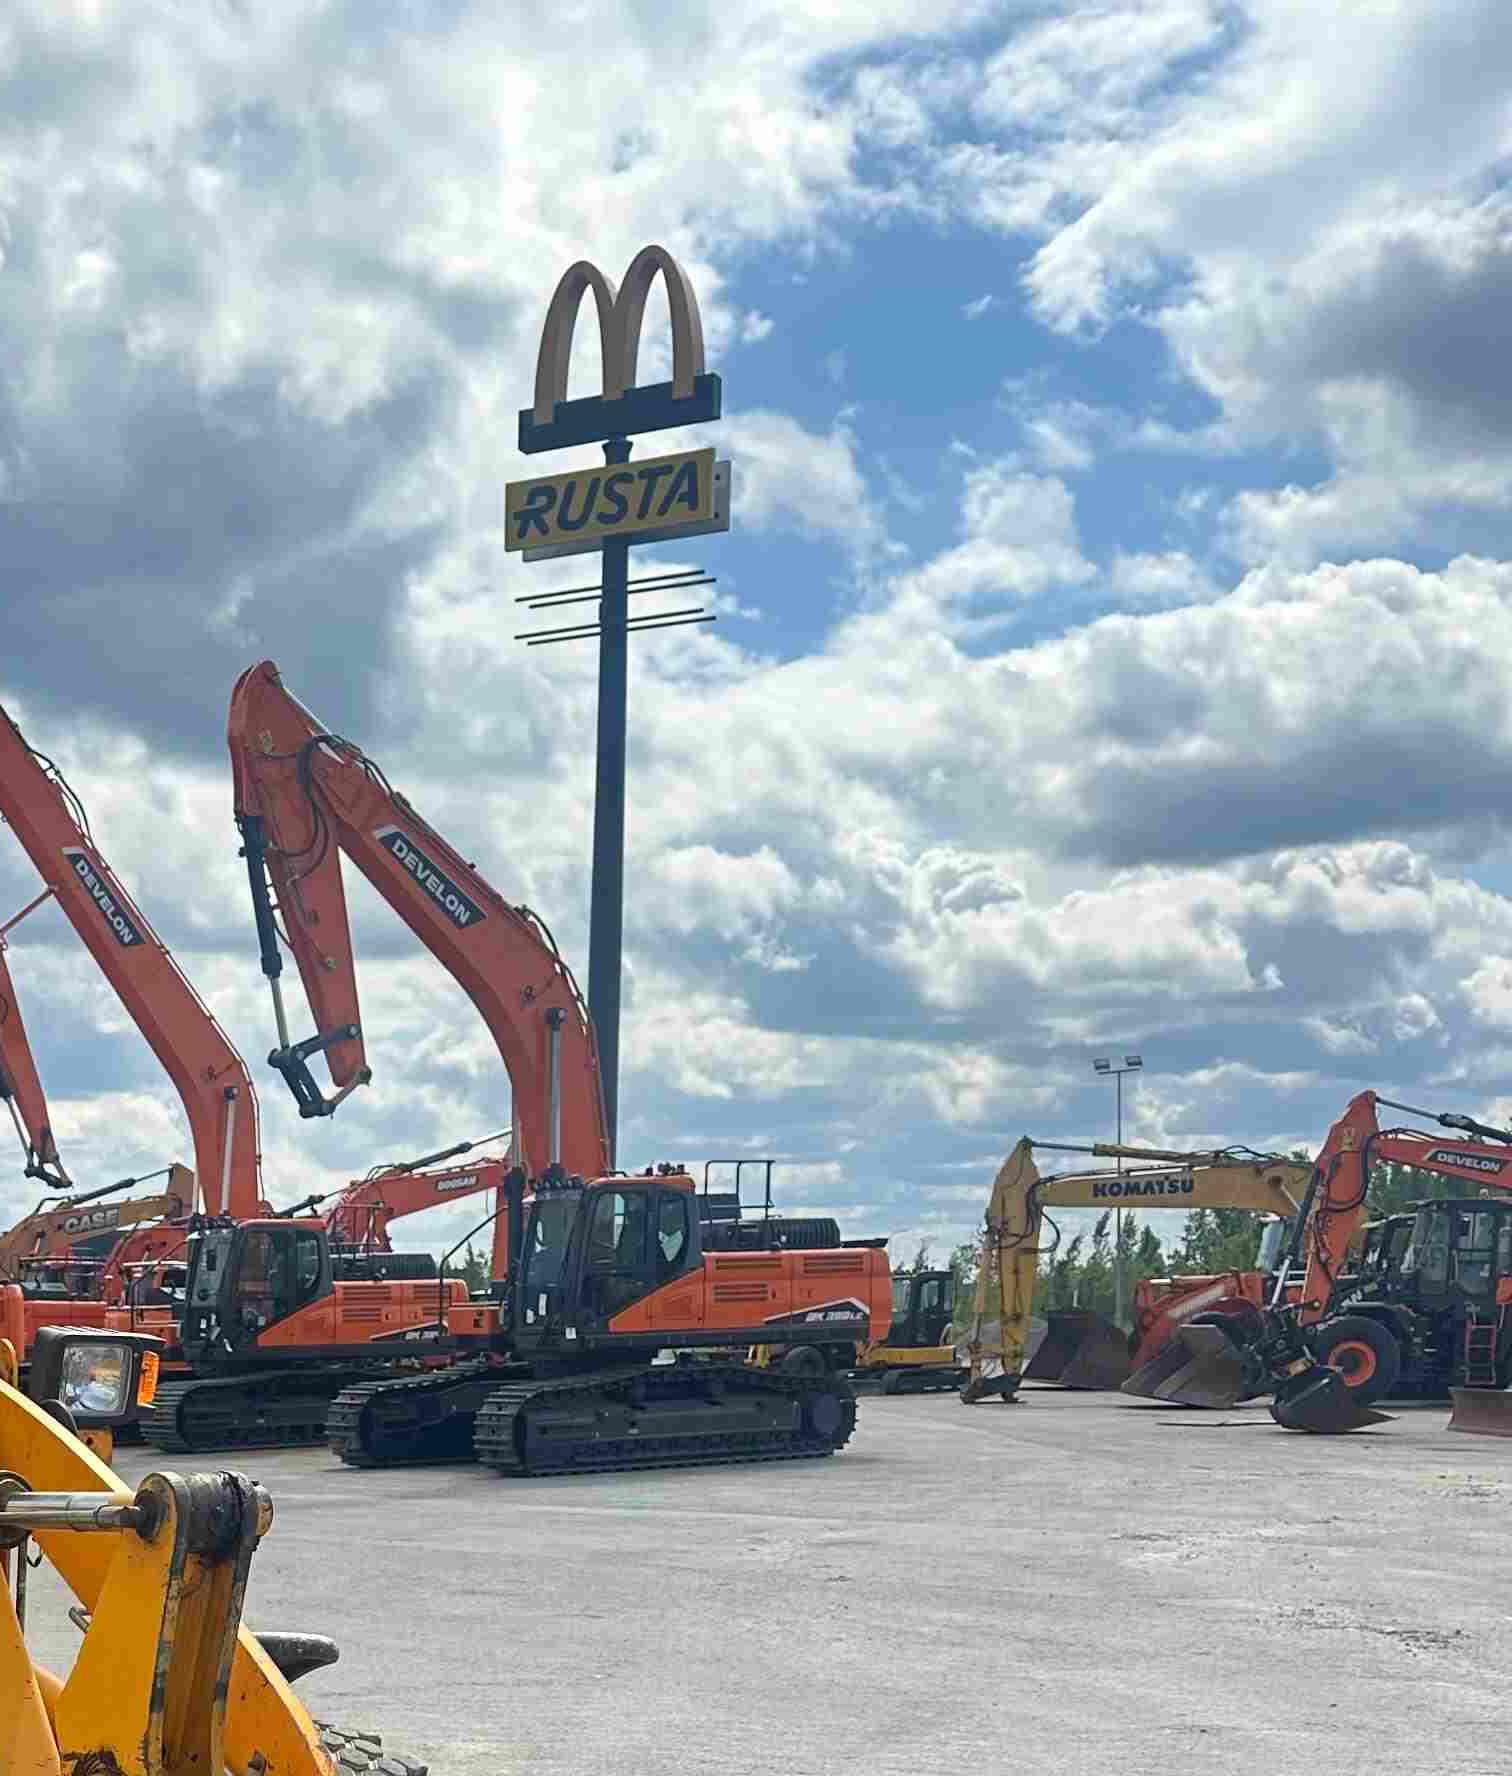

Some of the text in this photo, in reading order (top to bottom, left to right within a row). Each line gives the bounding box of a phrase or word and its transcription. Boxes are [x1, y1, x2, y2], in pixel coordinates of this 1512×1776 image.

[513, 461, 698, 540] RUSTA
[75, 859, 134, 944] DEVELON
[391, 839, 471, 924] DEVELON
[1094, 1178, 1193, 1197] KOMATSU
[1437, 1152, 1500, 1172] DEVELON
[64, 1208, 120, 1233] CASE
